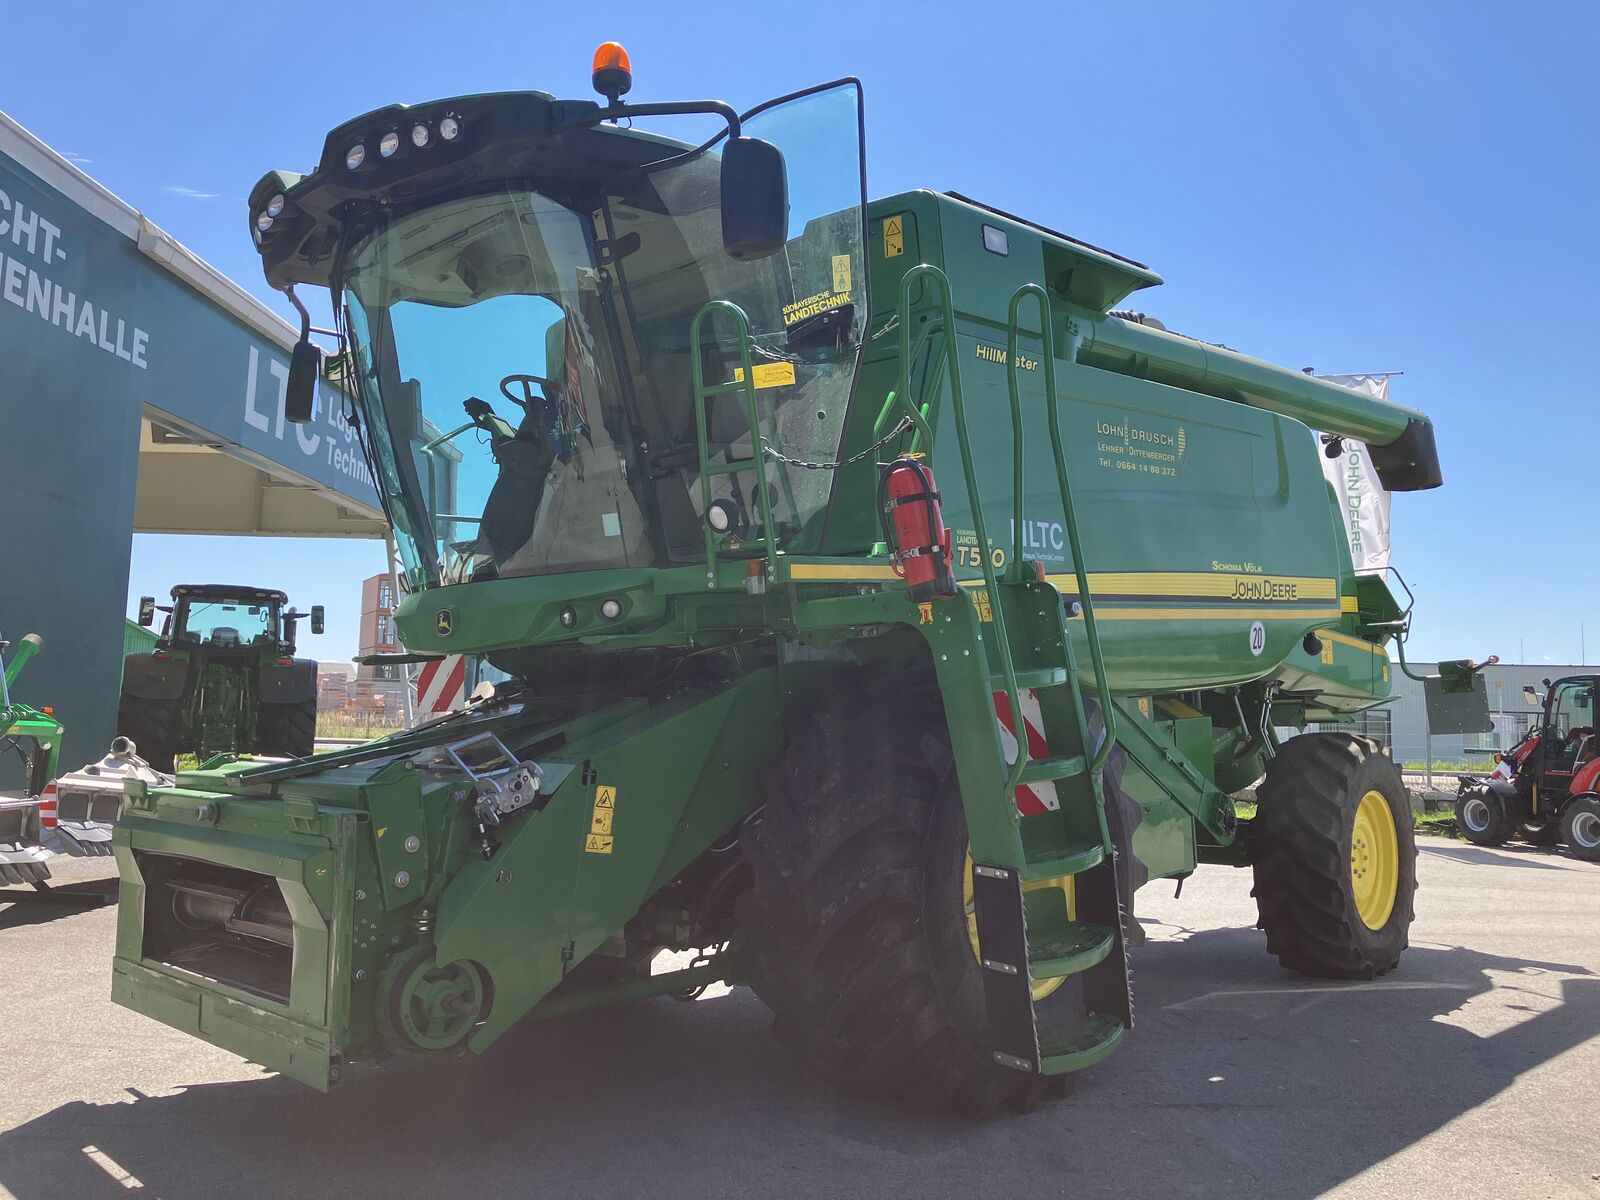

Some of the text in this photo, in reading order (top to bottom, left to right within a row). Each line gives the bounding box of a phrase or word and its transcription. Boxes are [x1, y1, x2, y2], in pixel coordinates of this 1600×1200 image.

[0, 252, 149, 370] ENHALLE
[782, 290, 831, 314] SÜDBAYERISCHE
[783, 291, 851, 325] LANDTECHNIK
[976, 344, 1038, 371] HillMster
[1097, 420, 1174, 446] LOHN DRUSCH
[1098, 458, 1114, 468] Tel.
[1116, 460, 1136, 470] 0664
[1139, 464, 1148, 472] 14
[1161, 467, 1176, 476] 372
[1348, 443, 1362, 553] JOHN DEERE
[957, 545, 1006, 569] T50
[1231, 578, 1298, 599] JOHN DEERE
[1252, 627, 1263, 650] 20
